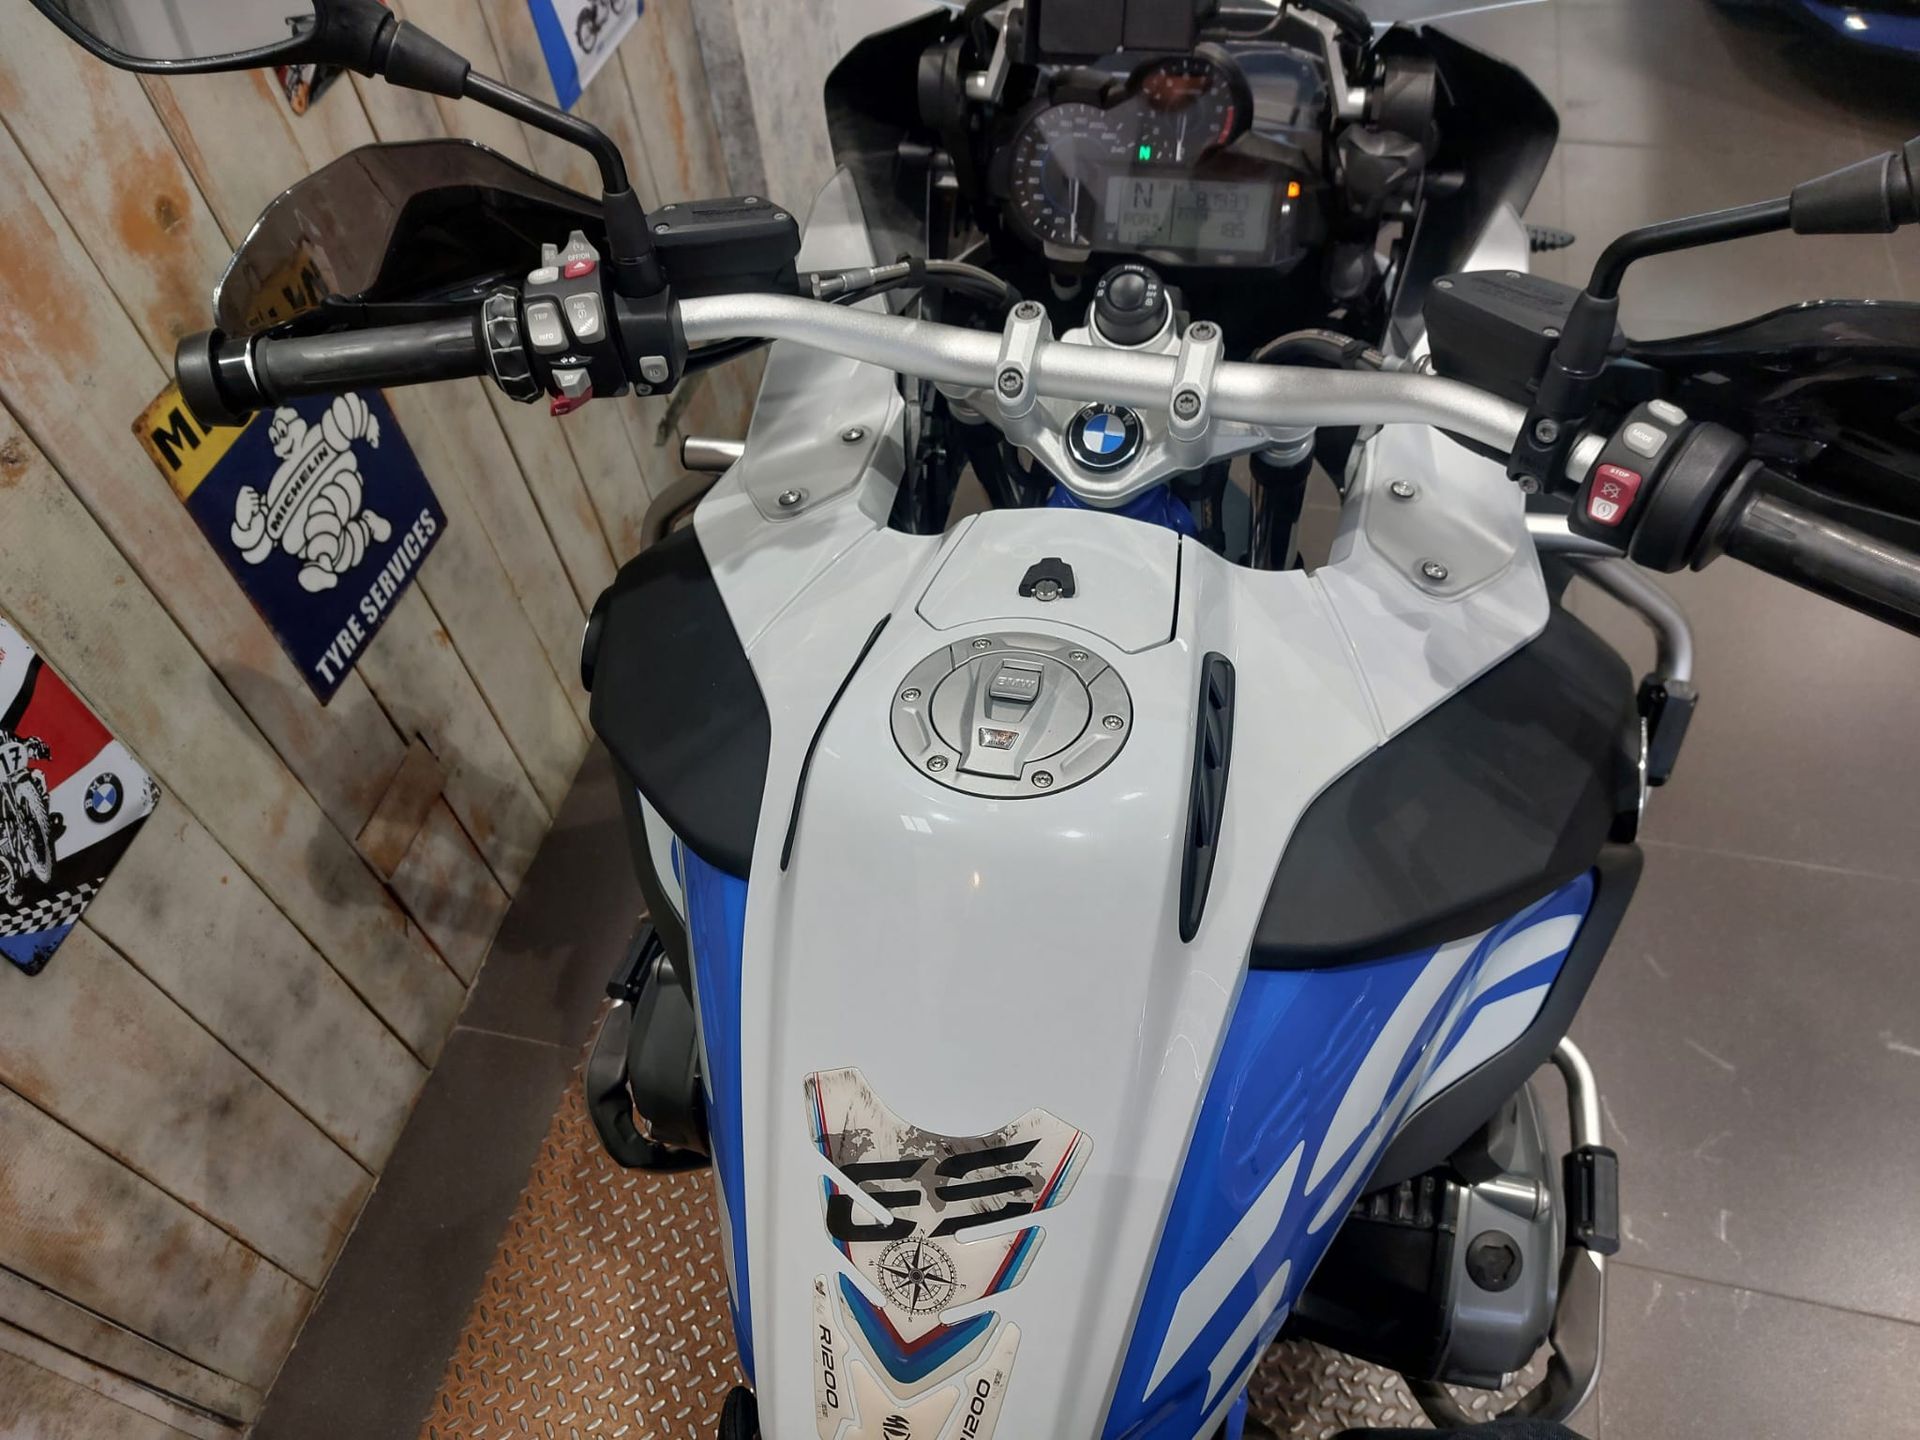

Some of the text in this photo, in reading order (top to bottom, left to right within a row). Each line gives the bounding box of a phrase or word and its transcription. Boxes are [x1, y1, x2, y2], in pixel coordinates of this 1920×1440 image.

[1139, 145, 1151, 160] N
[1133, 181, 1154, 209] N
[573, 302, 585, 310] ABS
[534, 312, 548, 321] TRIP
[539, 332, 554, 341] INFO
[1082, 403, 1135, 426] BMW
[1633, 429, 1652, 442] MODE
[1609, 468, 1630, 478] STOP
[271, 446, 329, 532] MICHELIN
[315, 508, 438, 685] TYRE SERVICES
[998, 676, 1036, 689] BMW
[85, 773, 113, 808] BMW
[819, 1324, 839, 1409] R1200
[958, 1378, 991, 1440] 1200
